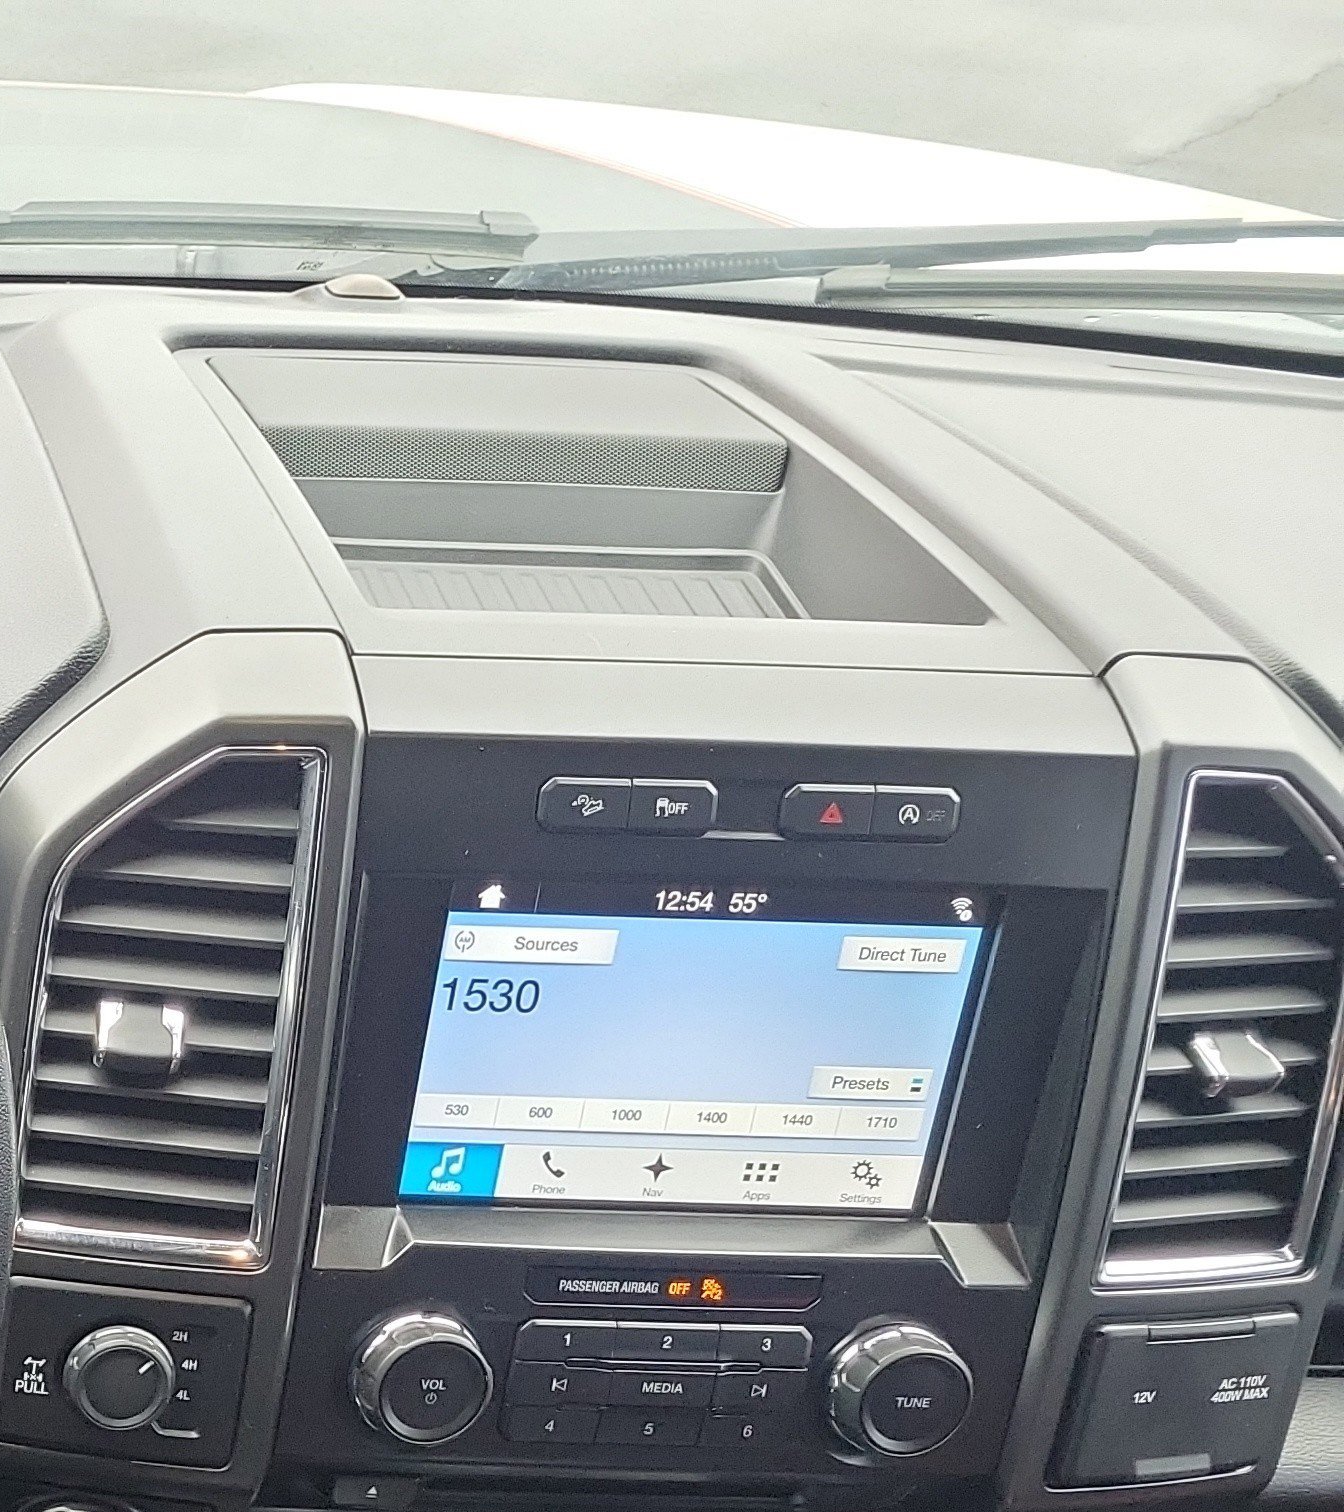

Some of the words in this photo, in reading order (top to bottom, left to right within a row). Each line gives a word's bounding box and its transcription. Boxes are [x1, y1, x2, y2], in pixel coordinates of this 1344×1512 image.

[668, 802, 689, 815] OFF
[655, 890, 714, 912] 12:54
[728, 891, 768, 914] 55°
[514, 936, 579, 952] Sources
[858, 946, 906, 962] Direct
[910, 948, 947, 964] Tune
[443, 977, 540, 1014] 1530
[831, 1075, 890, 1091] Presets
[444, 1104, 469, 1116] 530
[529, 1107, 553, 1119] 600
[611, 1109, 642, 1121] 1000
[696, 1112, 728, 1124] 1400
[782, 1114, 813, 1126] 1440
[867, 1117, 898, 1129] 1710
[427, 1180, 462, 1193] Audio
[532, 1185, 566, 1196] Phone
[642, 1187, 663, 1198] Nav
[742, 1190, 771, 1201] Apps
[839, 1193, 882, 1205] Settings
[559, 1280, 621, 1293] PASSENGER
[620, 1281, 660, 1294] AIRBAG
[668, 1282, 691, 1295] OFF
[172, 1330, 189, 1342] 2H
[562, 1333, 572, 1347] 1
[662, 1334, 673, 1350] 2
[761, 1337, 772, 1352] 3
[181, 1359, 198, 1371] 4H
[14, 1379, 49, 1395] PULL
[421, 1378, 446, 1392] VOL
[641, 1381, 683, 1395] MEDIA
[1218, 1377, 1238, 1390] AC
[1239, 1375, 1267, 1388] 110V
[896, 1396, 930, 1410] TUNE
[1133, 1390, 1157, 1404] 12V
[544, 1419, 555, 1433] 4
[643, 1421, 654, 1436] 5
[742, 1423, 753, 1438] 6
